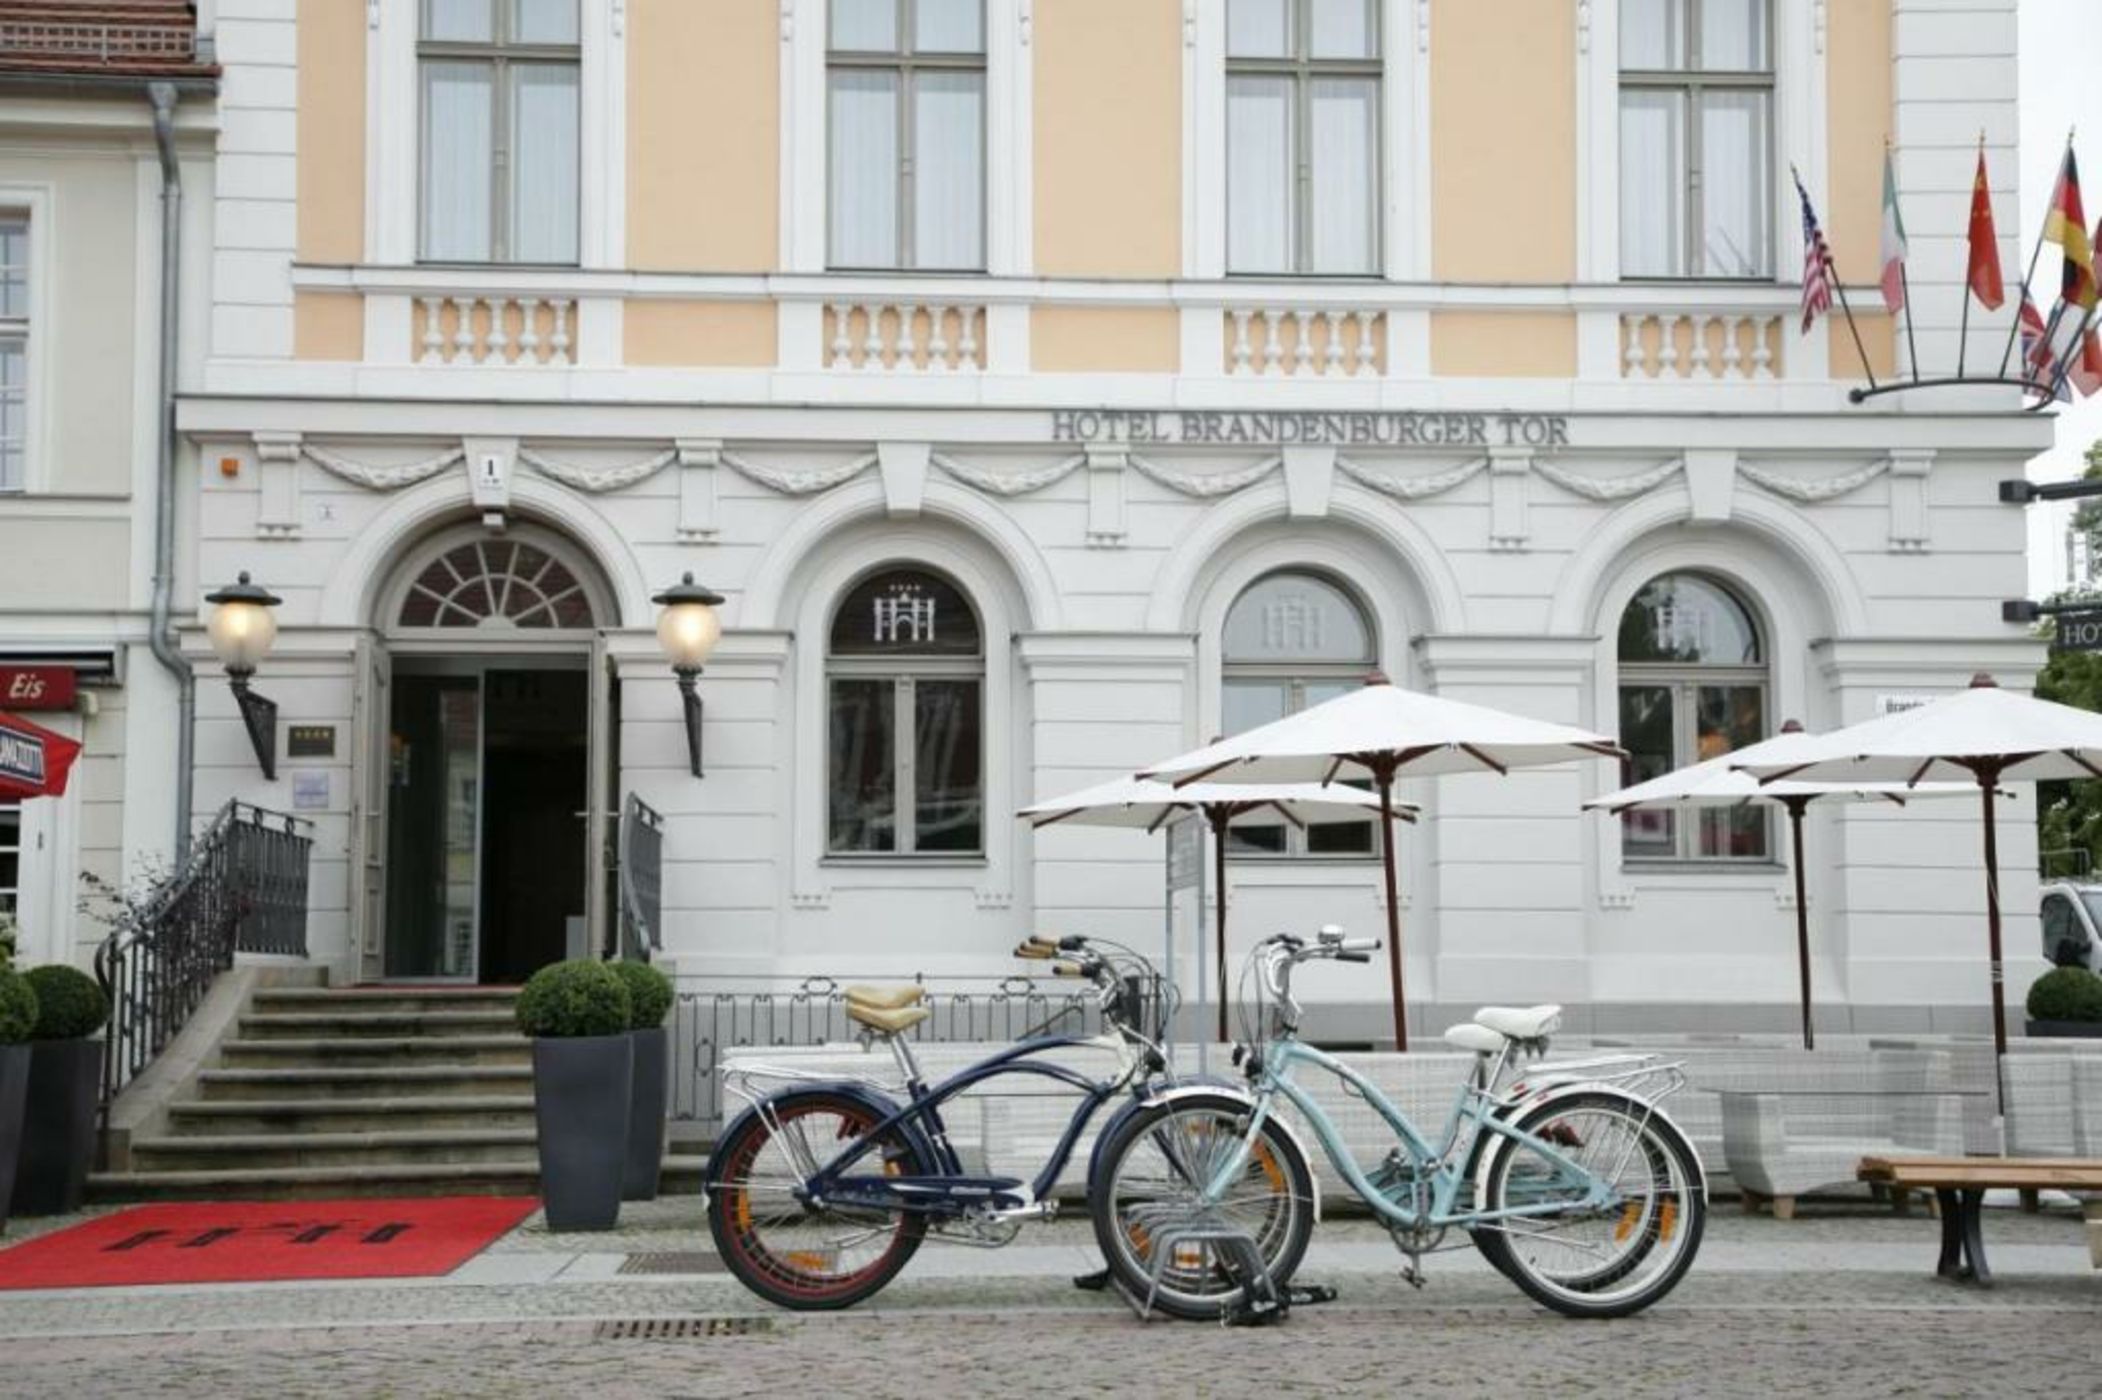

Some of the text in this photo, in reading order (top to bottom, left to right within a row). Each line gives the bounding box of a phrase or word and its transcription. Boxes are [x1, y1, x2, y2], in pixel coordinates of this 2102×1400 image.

[1052, 413, 1569, 445] HOTEL BRANDENBURGER TOR
[2064, 623, 2102, 644] HO
[9, 673, 46, 698] Eis
